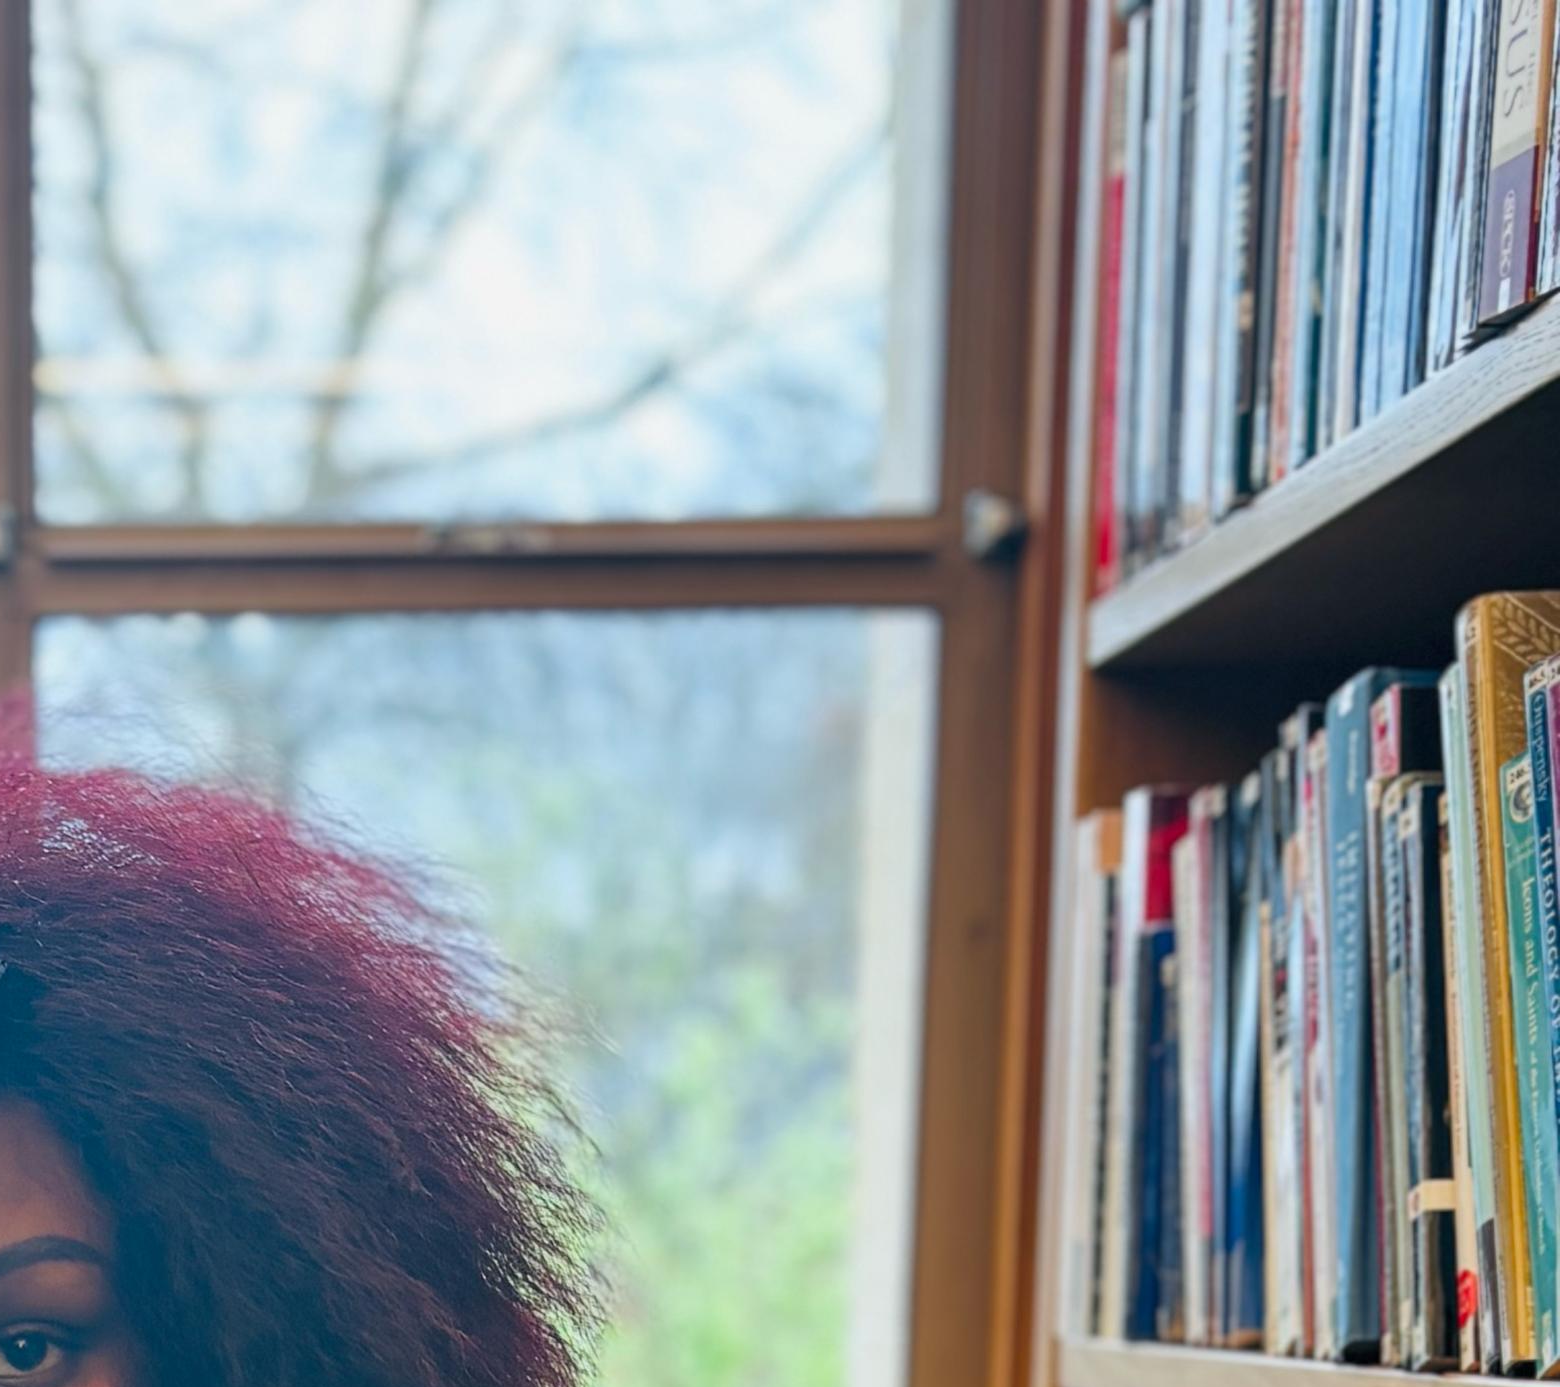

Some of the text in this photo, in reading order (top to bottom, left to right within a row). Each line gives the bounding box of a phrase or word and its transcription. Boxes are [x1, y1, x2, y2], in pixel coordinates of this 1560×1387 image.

[1531, 692, 1551, 804] Ouspensky
[1522, 876, 1536, 936] Icons
[1540, 826, 1560, 981] THEOLOGY
[1524, 939, 1538, 978] and
[1526, 981, 1538, 1045] Saints
